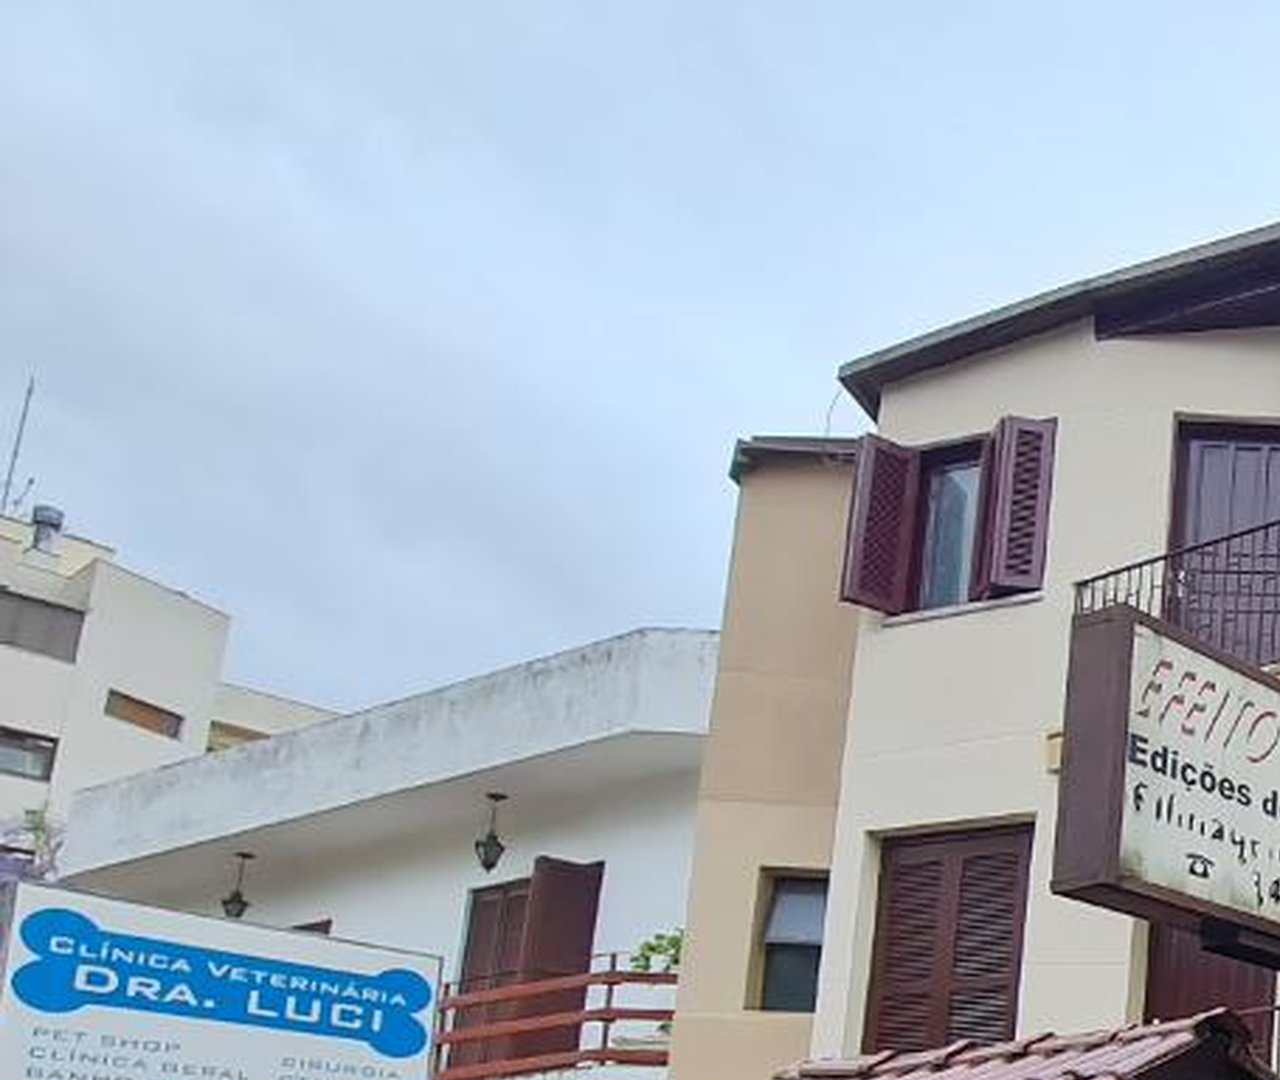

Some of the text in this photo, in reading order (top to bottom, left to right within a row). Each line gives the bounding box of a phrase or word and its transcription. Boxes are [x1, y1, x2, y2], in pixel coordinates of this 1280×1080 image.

[1127, 732, 1252, 807] Edições
[50, 936, 407, 1007] CLÍNICA VETERINÁRIA
[74, 963, 384, 1033] DRA. LUCI
[32, 1025, 181, 1054] PET SHOP
[281, 1056, 401, 1080] CIRURGIA
